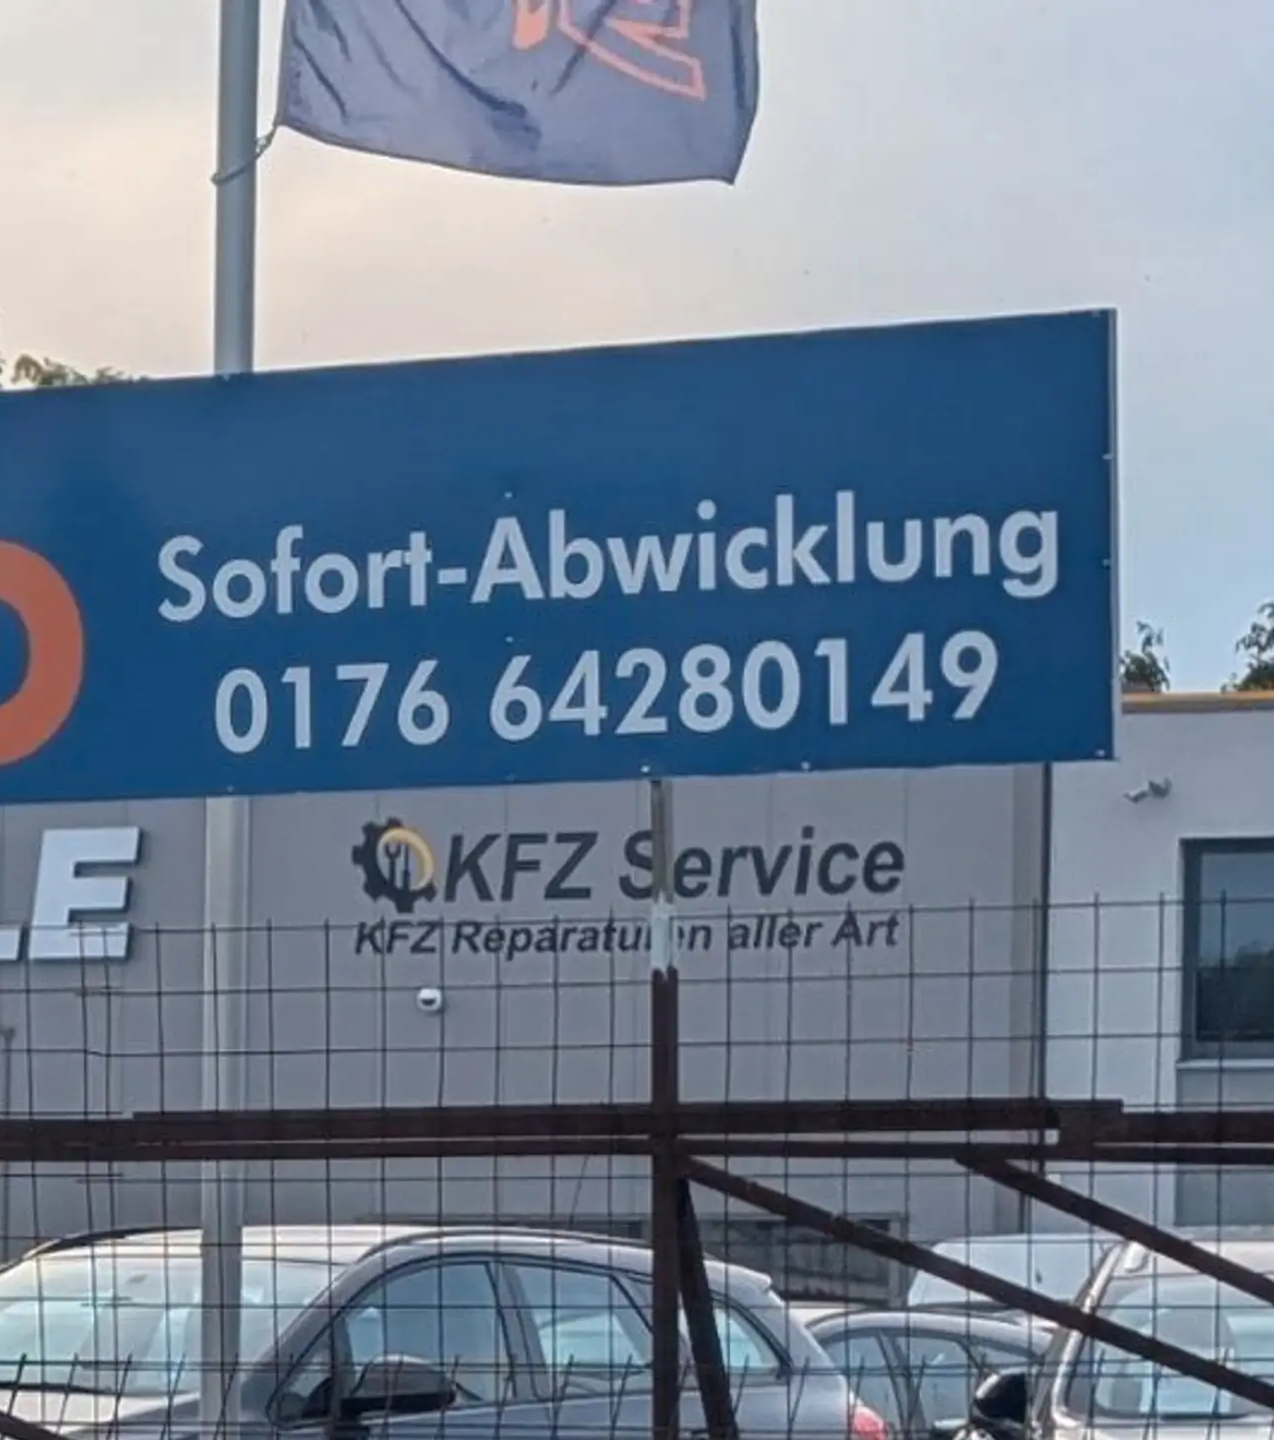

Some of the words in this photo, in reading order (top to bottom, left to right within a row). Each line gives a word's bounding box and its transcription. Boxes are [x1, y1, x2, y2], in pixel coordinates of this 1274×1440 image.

[156, 490, 1059, 623] Sofort-Abwicklung
[214, 659, 450, 755] 0176
[489, 630, 999, 743] 64280149
[443, 830, 599, 903] KFZ
[618, 826, 906, 901] Service
[354, 920, 439, 955] KFZ
[452, 918, 712, 961] Reparatun
[728, 914, 821, 950] aller
[831, 911, 901, 948] Art
